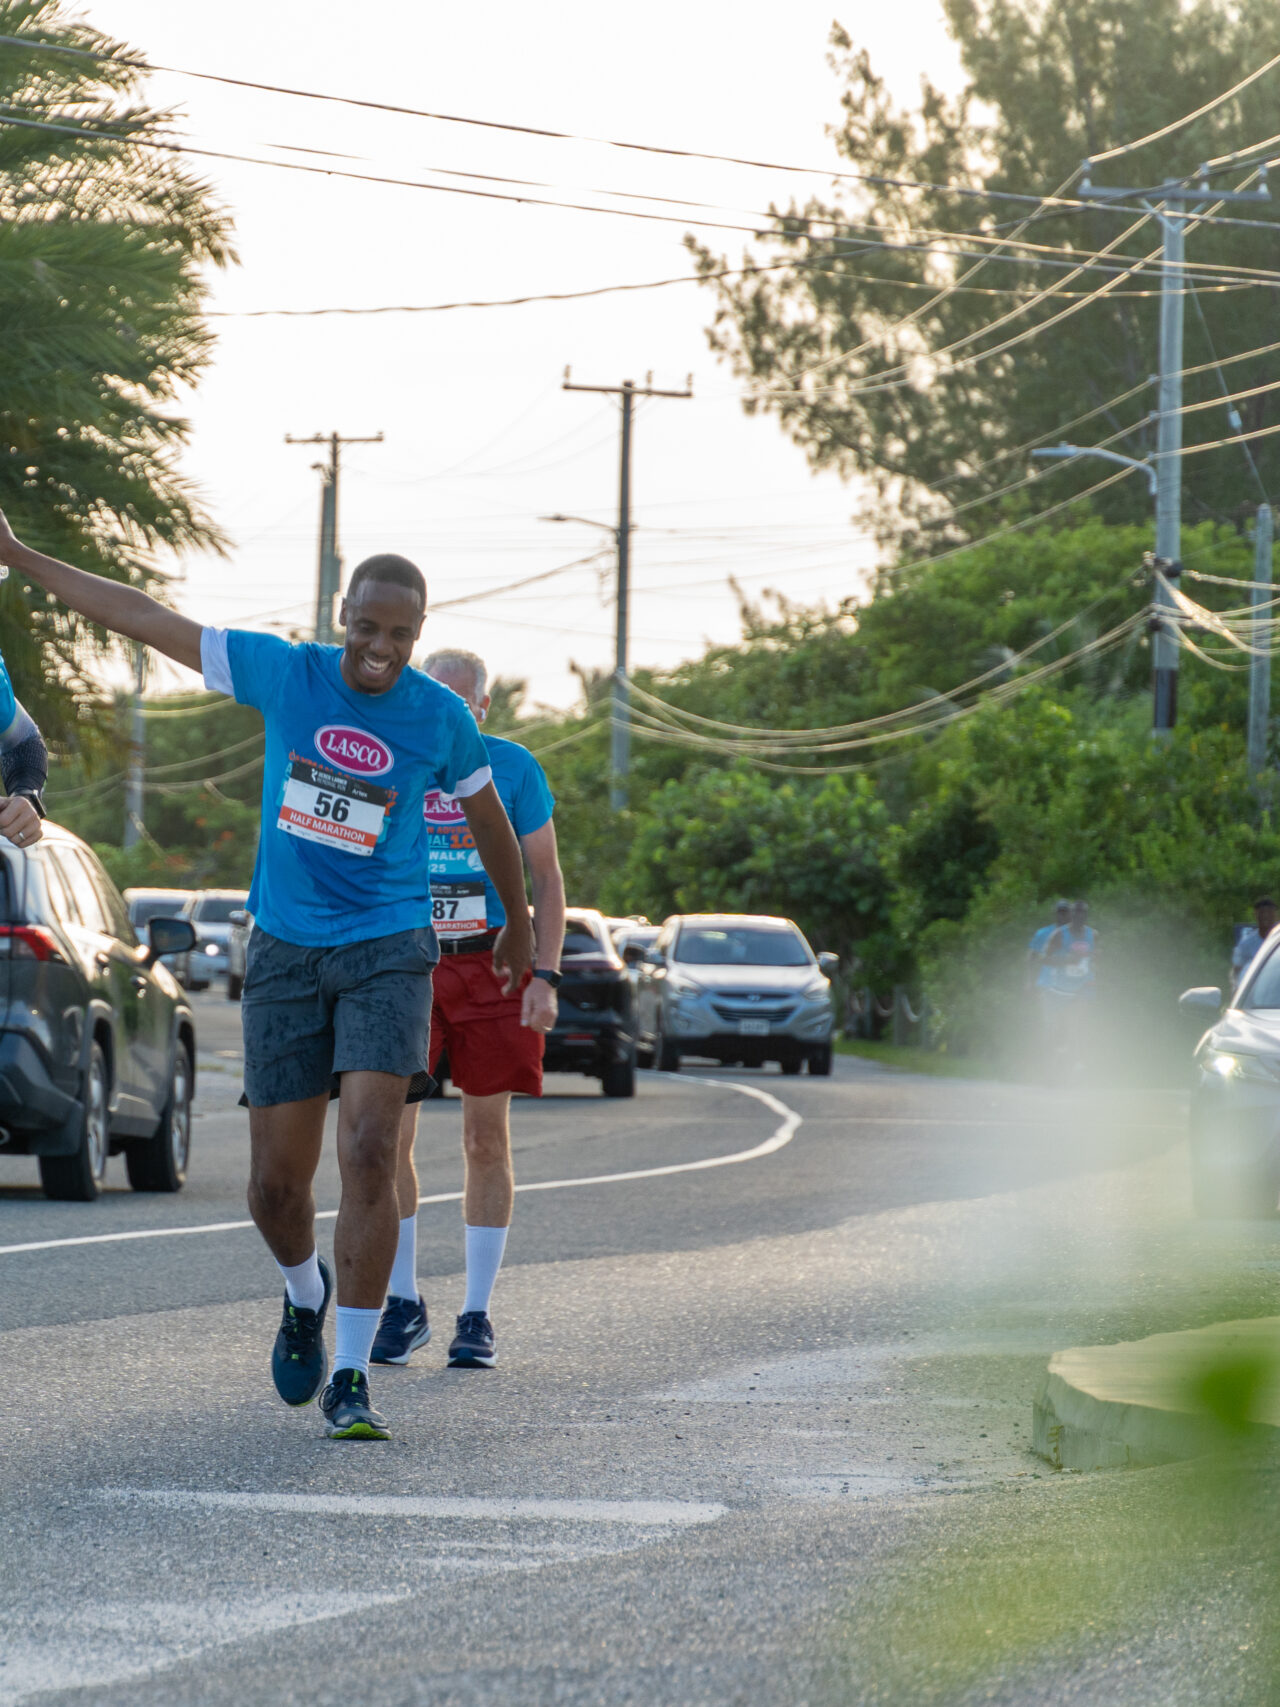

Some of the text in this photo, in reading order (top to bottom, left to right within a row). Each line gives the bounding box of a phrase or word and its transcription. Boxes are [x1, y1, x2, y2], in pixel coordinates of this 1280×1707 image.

[325, 733, 381, 767] LASCO
[313, 791, 351, 823] 56
[289, 811, 313, 826] HALF
[312, 819, 366, 843] MARATHON
[450, 834, 476, 849] 10
[429, 851, 466, 861] WALK
[432, 899, 459, 920] 87
[434, 922, 478, 930] MARATHON
